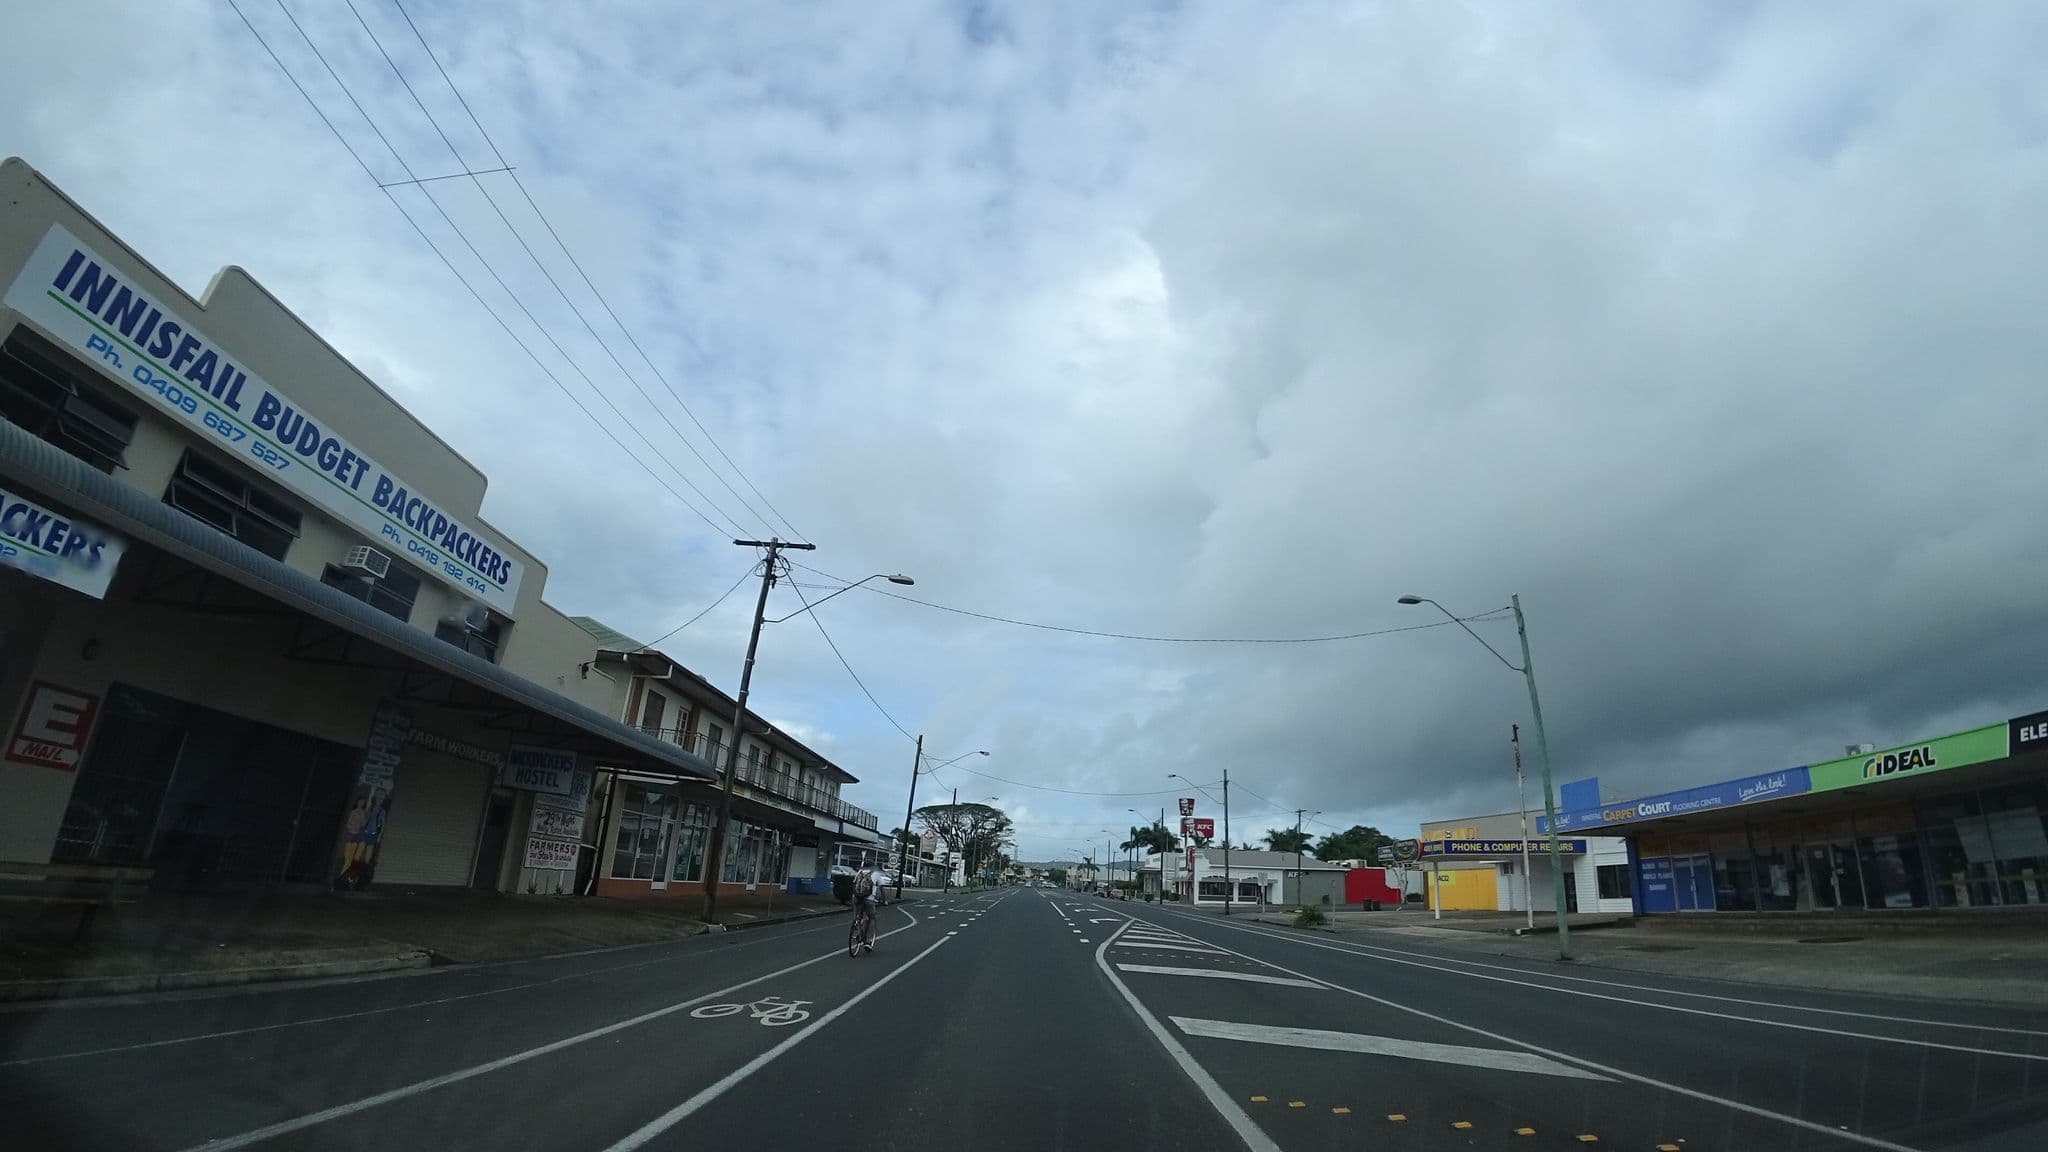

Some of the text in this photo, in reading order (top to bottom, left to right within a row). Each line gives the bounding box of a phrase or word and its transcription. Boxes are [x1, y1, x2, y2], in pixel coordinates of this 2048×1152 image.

[53, 249, 512, 585] INNISFAIL BUDGET BACKPACKERS
[86, 333, 291, 470] Ph. 0409 687 527
[0, 495, 106, 570] CKERS
[381, 524, 486, 594] Ph. 0418 192 414
[22, 687, 89, 748] E
[515, 767, 560, 788] HOSTEL
[1603, 808, 1637, 822] CARPET
[1638, 802, 1671, 816] COURT
[530, 840, 571, 854] FARMERS
[1452, 842, 1482, 852] PHONE
[1483, 842, 1490, 852] &
[1539, 842, 1574, 852] REIRS
